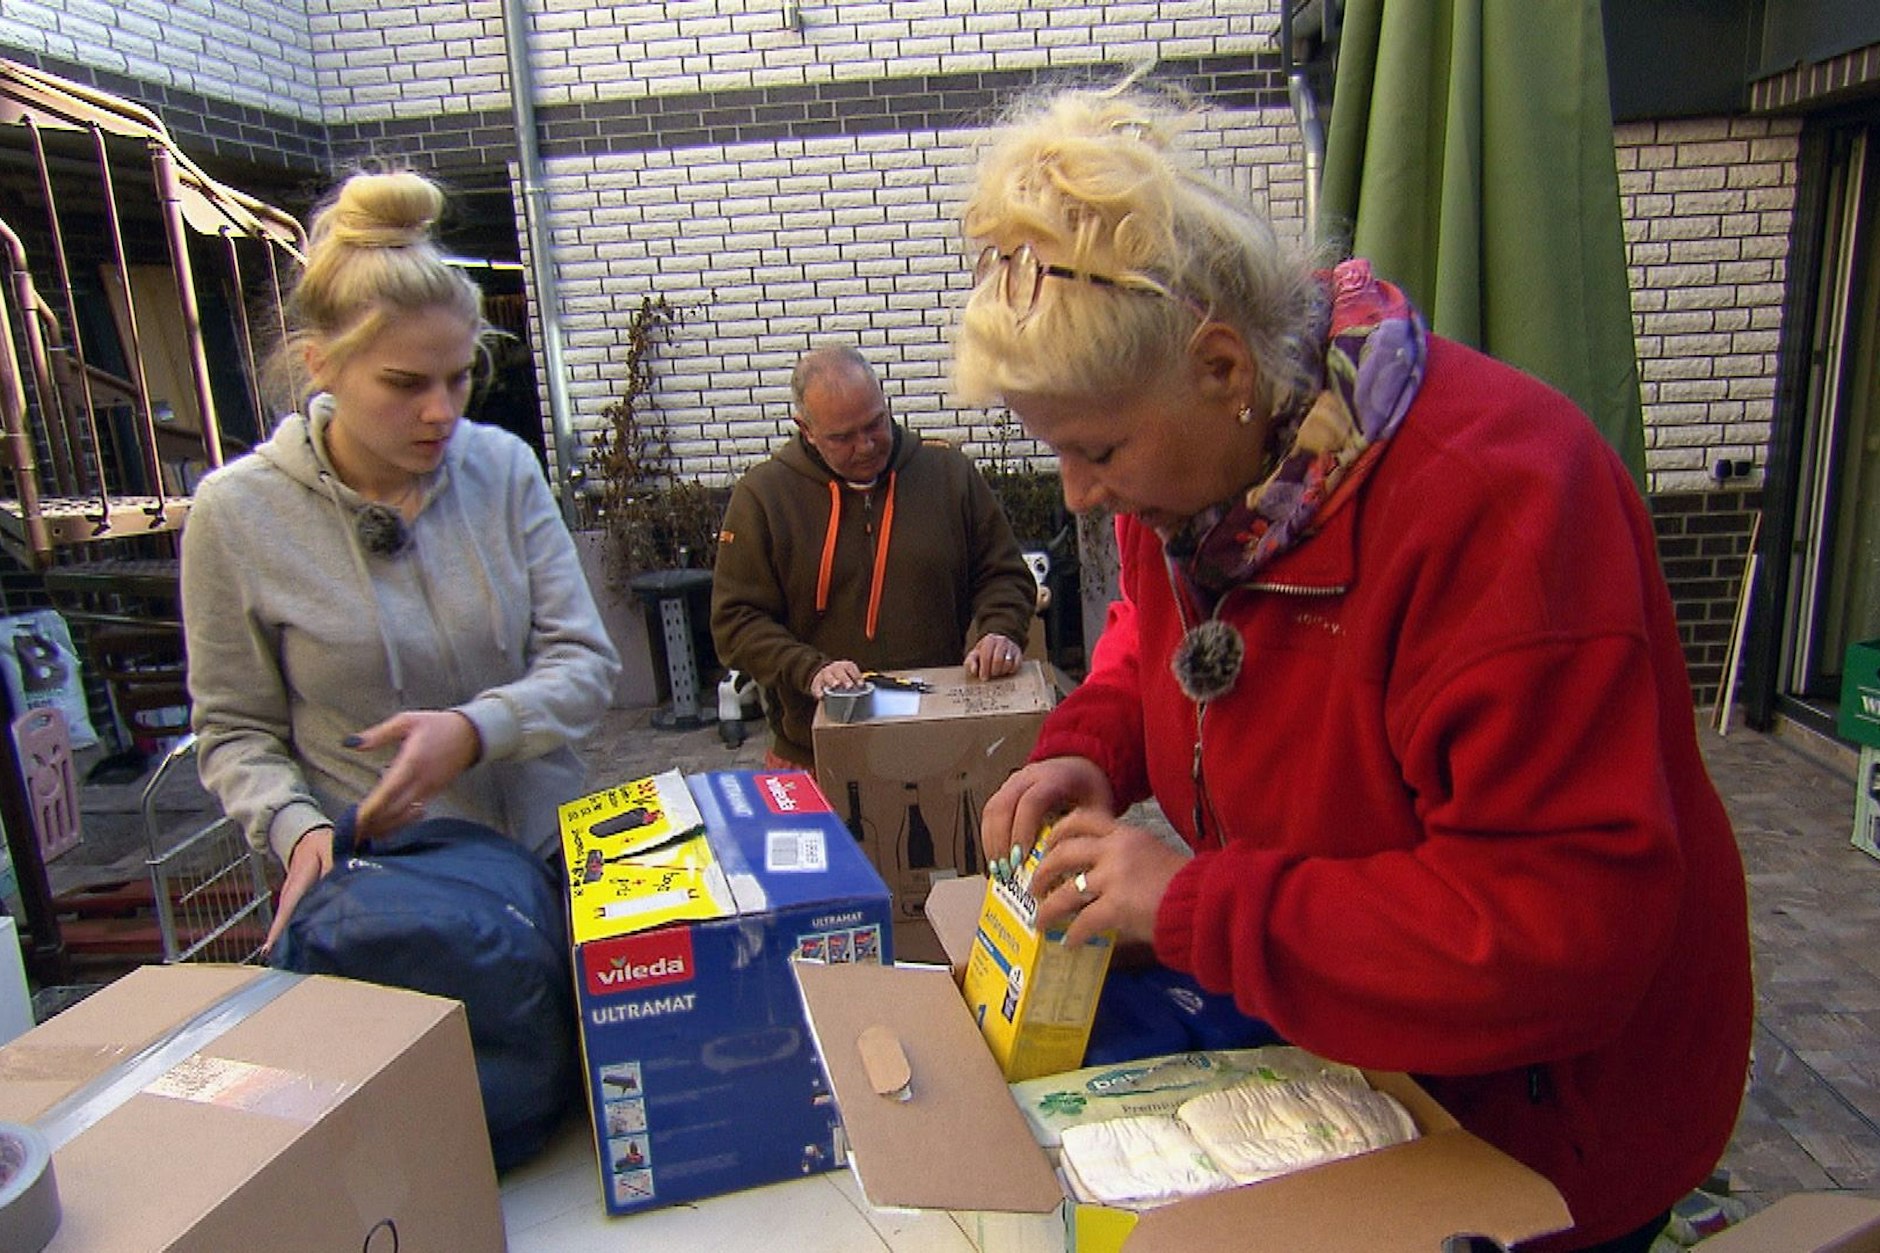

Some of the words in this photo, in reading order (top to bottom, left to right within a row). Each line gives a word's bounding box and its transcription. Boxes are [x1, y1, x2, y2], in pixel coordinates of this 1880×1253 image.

[811, 911, 864, 929] ULTRAMAT
[596, 957, 686, 986] vileda
[591, 994, 697, 1025] ULTRAMAT
